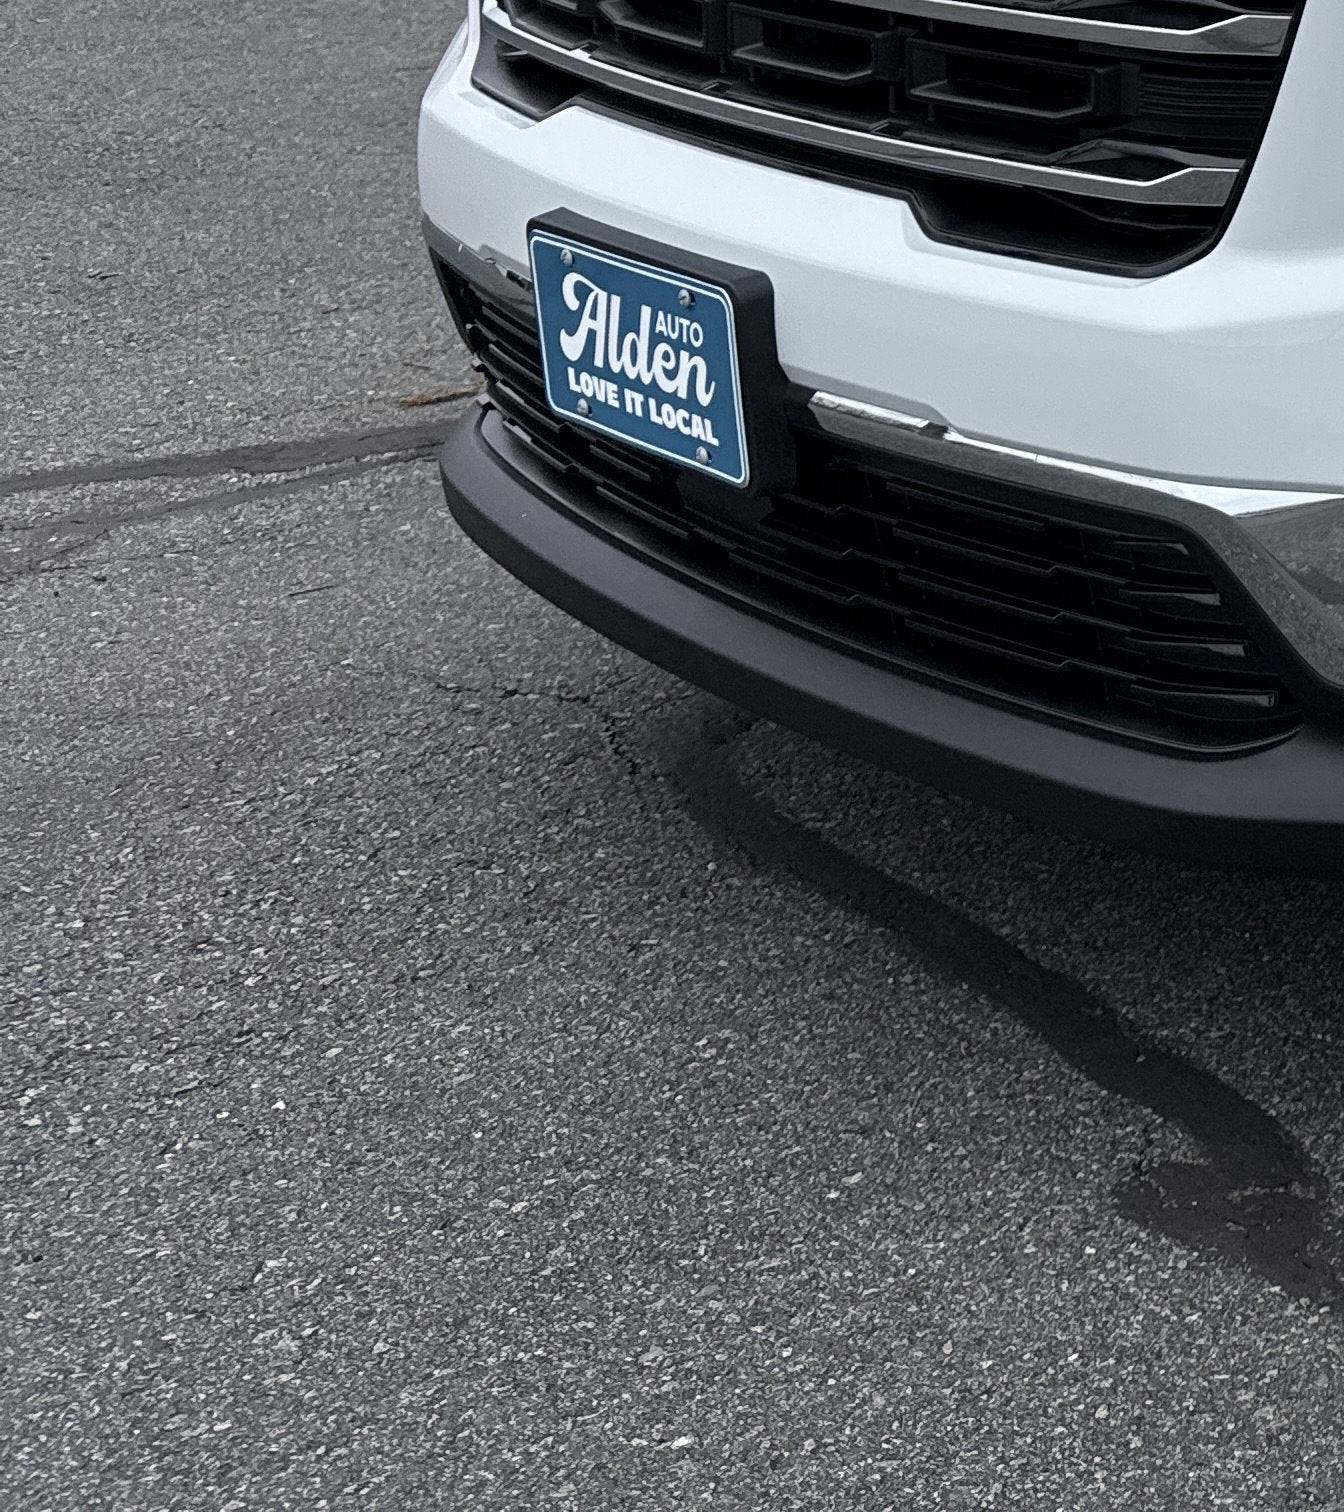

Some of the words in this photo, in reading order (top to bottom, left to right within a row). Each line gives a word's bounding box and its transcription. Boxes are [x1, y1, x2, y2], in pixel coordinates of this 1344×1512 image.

[558, 272, 716, 409] Alden
[655, 310, 704, 348] AUTO
[567, 367, 620, 409] LOVE
[624, 386, 644, 416] IT
[647, 398, 720, 447] LOCAL
